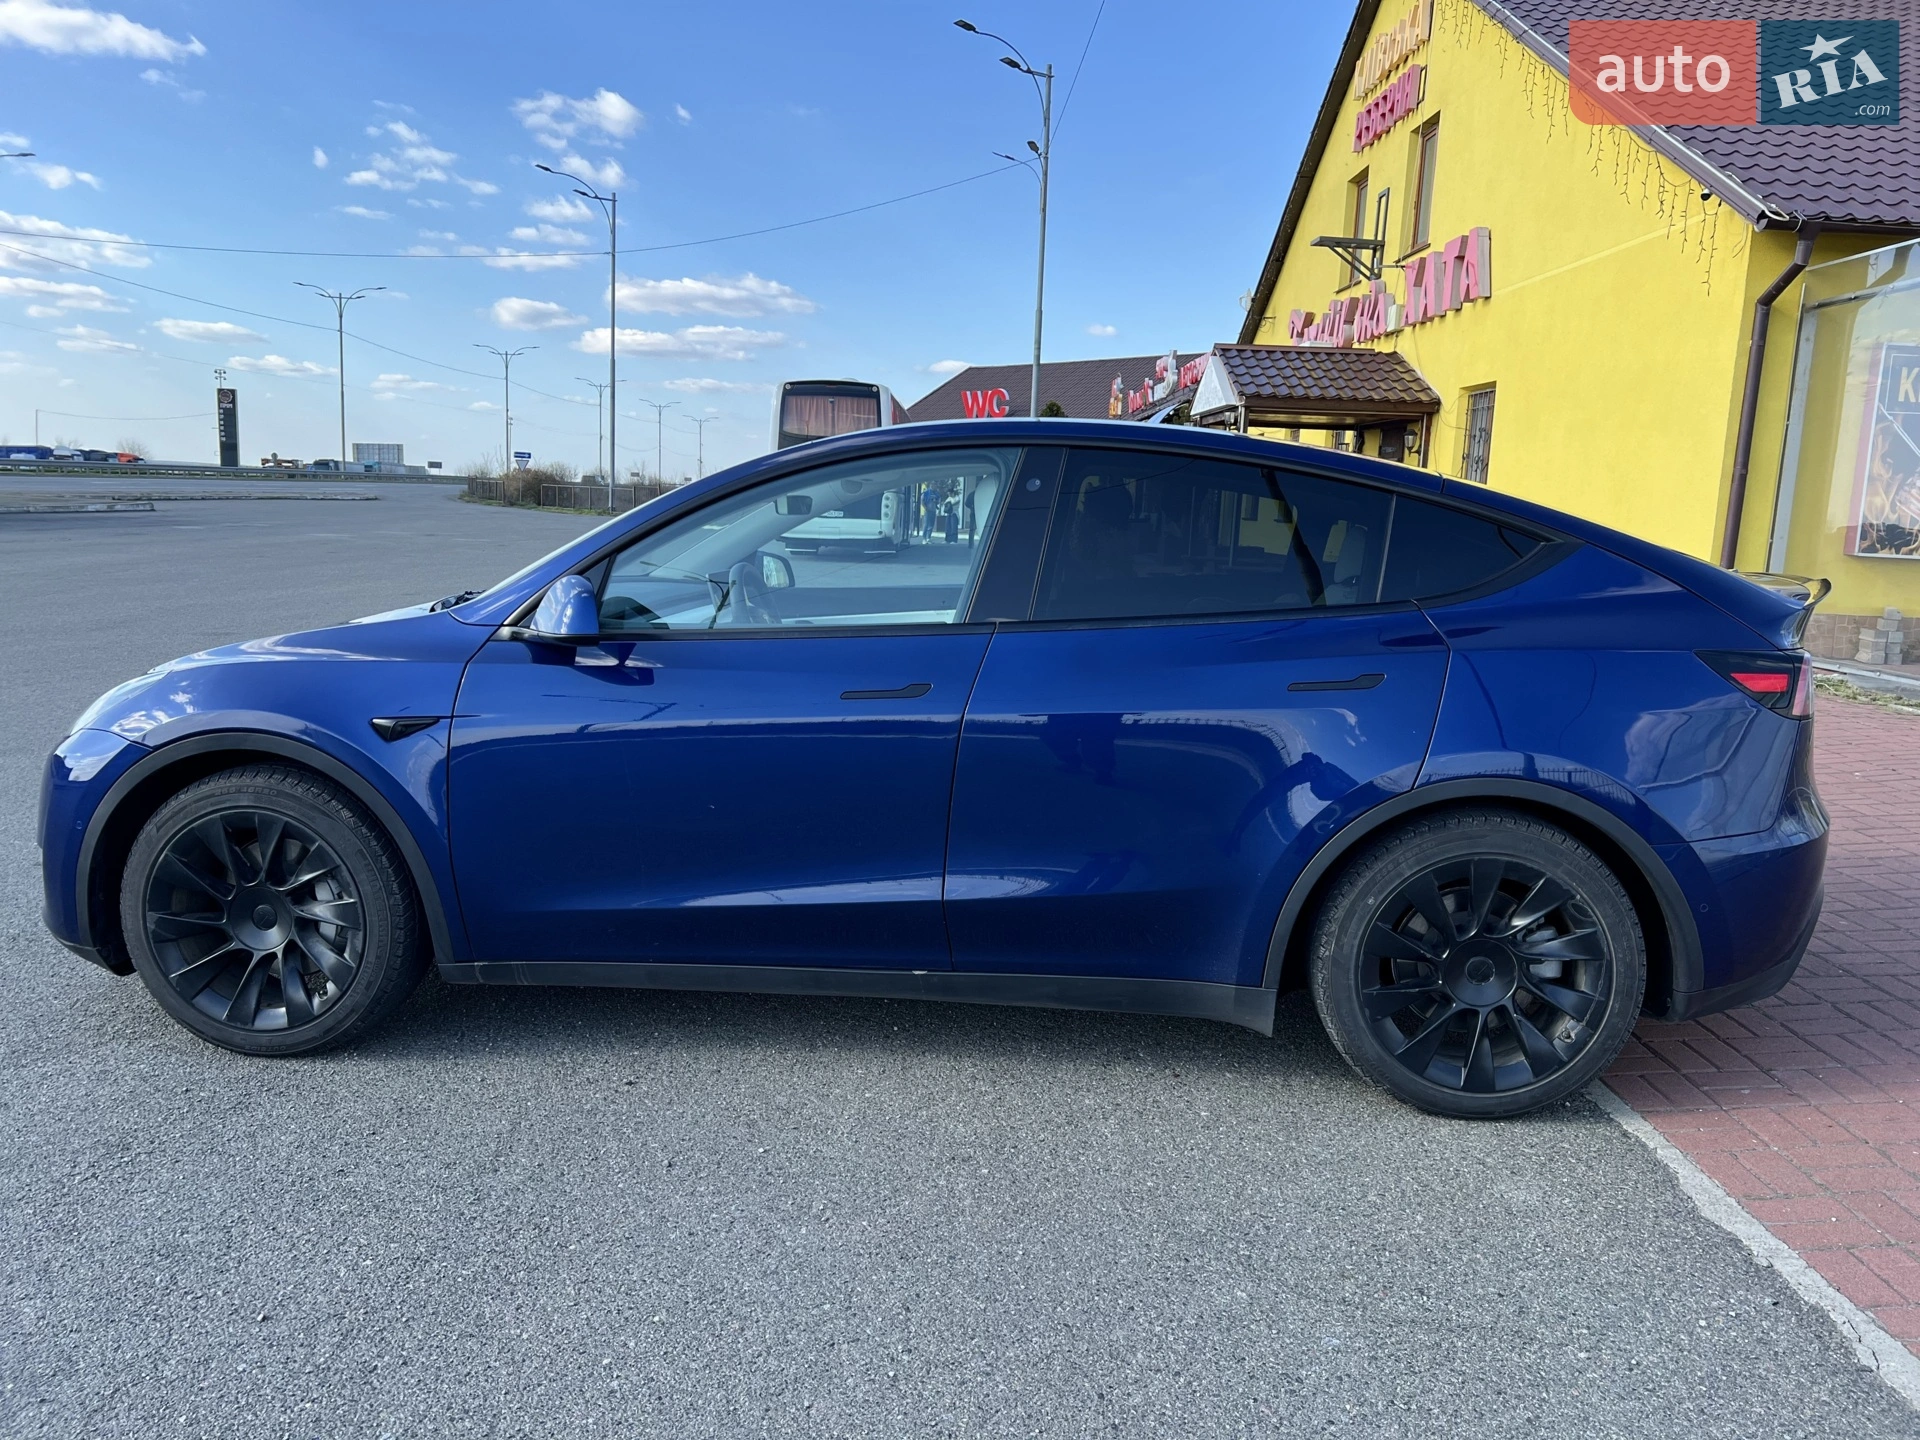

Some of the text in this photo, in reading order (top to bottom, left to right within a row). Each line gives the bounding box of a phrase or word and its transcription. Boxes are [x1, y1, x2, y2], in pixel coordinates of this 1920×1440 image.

[1353, 0, 1430, 101] КИЇВСЬКА
[1352, 64, 1420, 153] РЕБЕРНЯ
[1401, 227, 1491, 327] ХАТА
[961, 388, 1010, 418] WC
